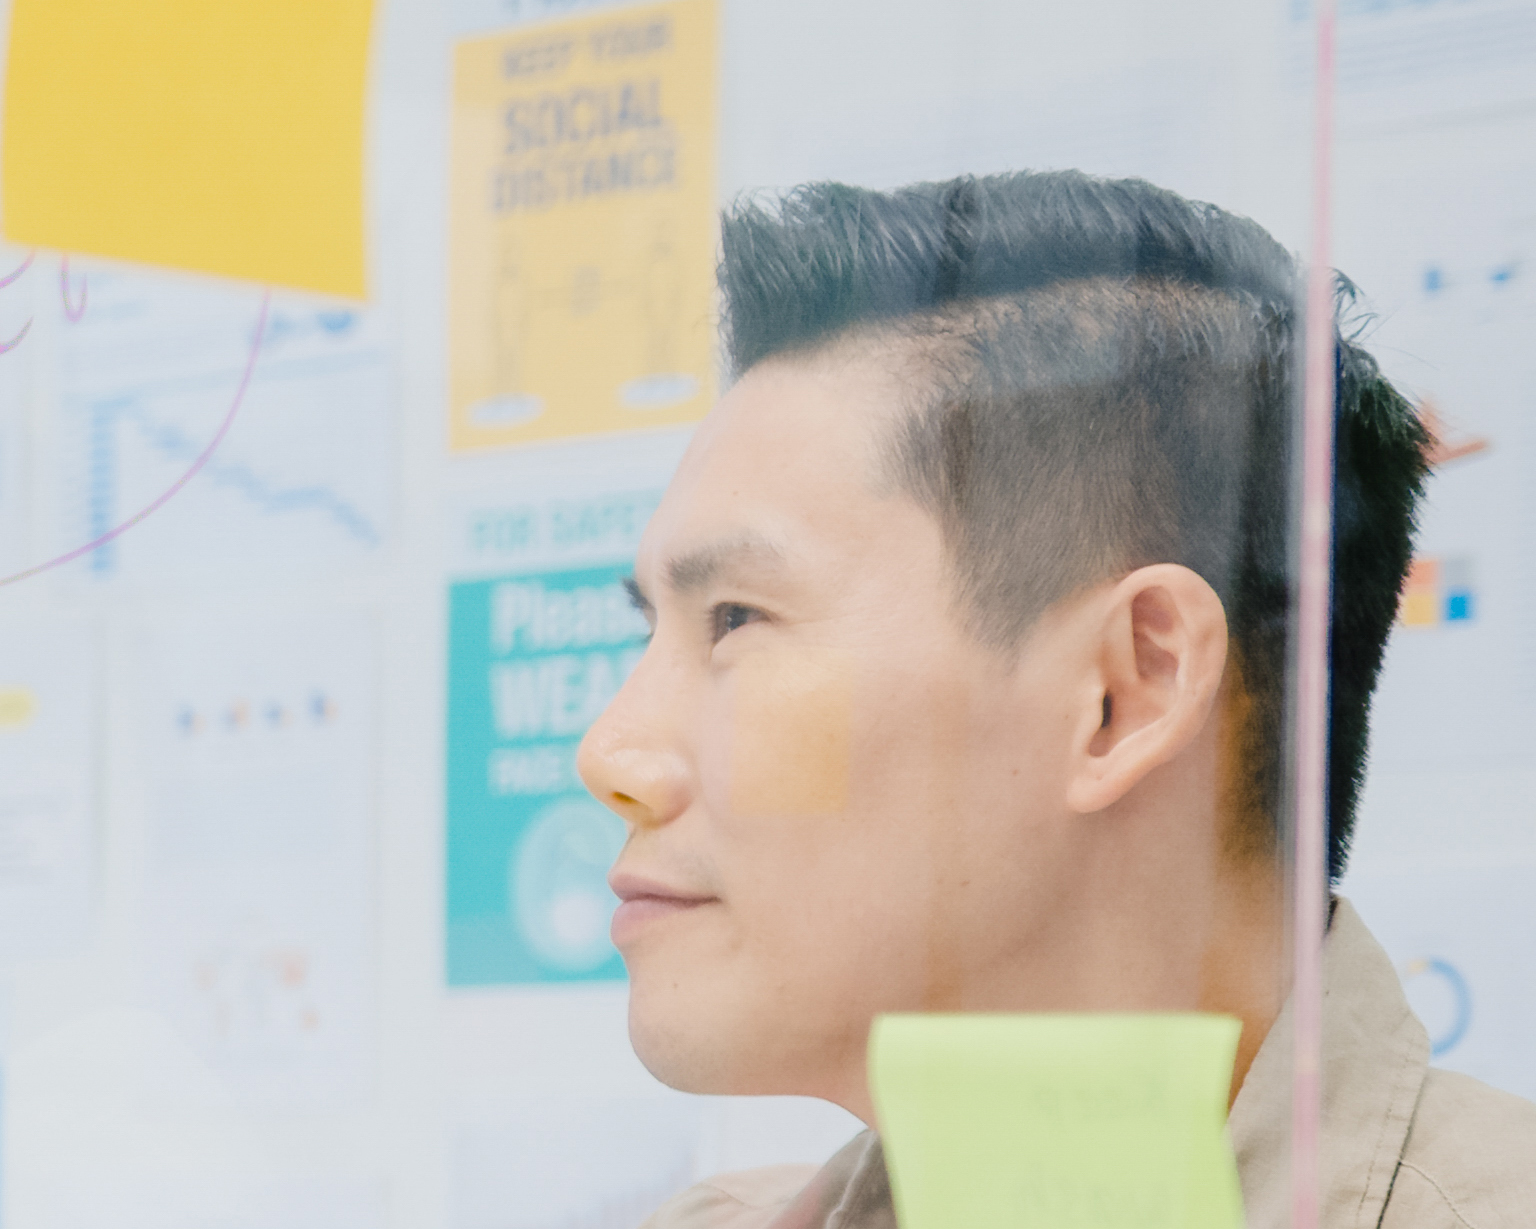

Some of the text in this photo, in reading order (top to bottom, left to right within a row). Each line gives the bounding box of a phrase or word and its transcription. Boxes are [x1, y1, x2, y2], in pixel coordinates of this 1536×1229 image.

[502, 78, 663, 155] SOCIAL
[489, 147, 679, 217] DISTANCE
[548, 488, 656, 545] SAFE
[493, 580, 653, 654] Pleas
[490, 650, 643, 738] WEA
